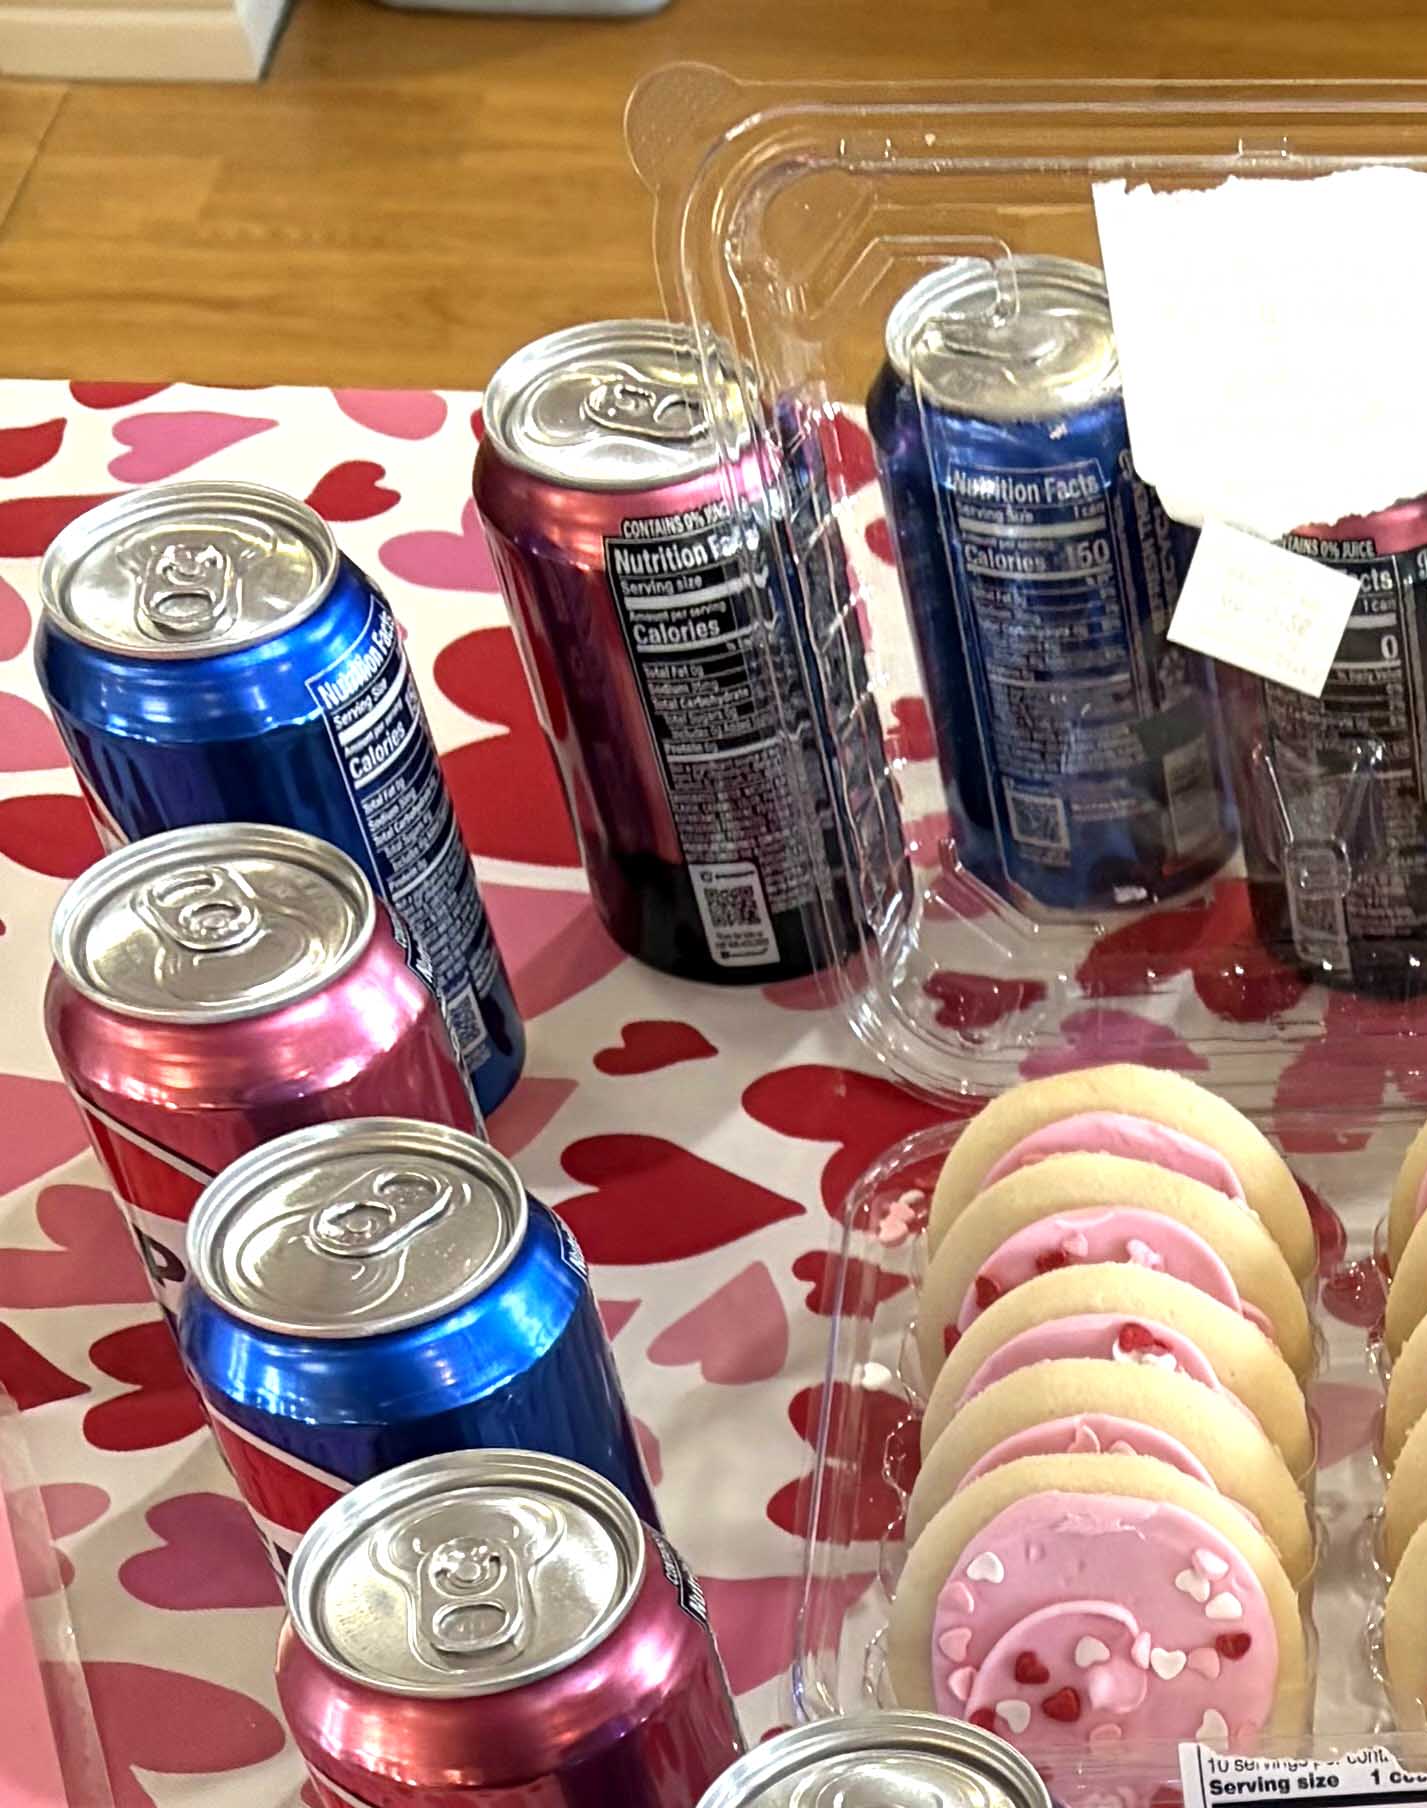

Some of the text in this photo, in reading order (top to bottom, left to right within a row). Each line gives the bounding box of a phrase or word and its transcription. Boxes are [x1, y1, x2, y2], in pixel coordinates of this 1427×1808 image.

[1043, 472, 1099, 503] Facts
[623, 516, 684, 539] CONTAINS
[614, 541, 708, 575] Nutrition
[1342, 539, 1376, 560] JUICE
[620, 575, 703, 596] Serving size
[1358, 569, 1394, 593] cts
[633, 618, 720, 645] Calories
[1380, 634, 1399, 662] 0
[350, 721, 406, 780] Calories
[1208, 1768, 1381, 1795] Serving size 1
